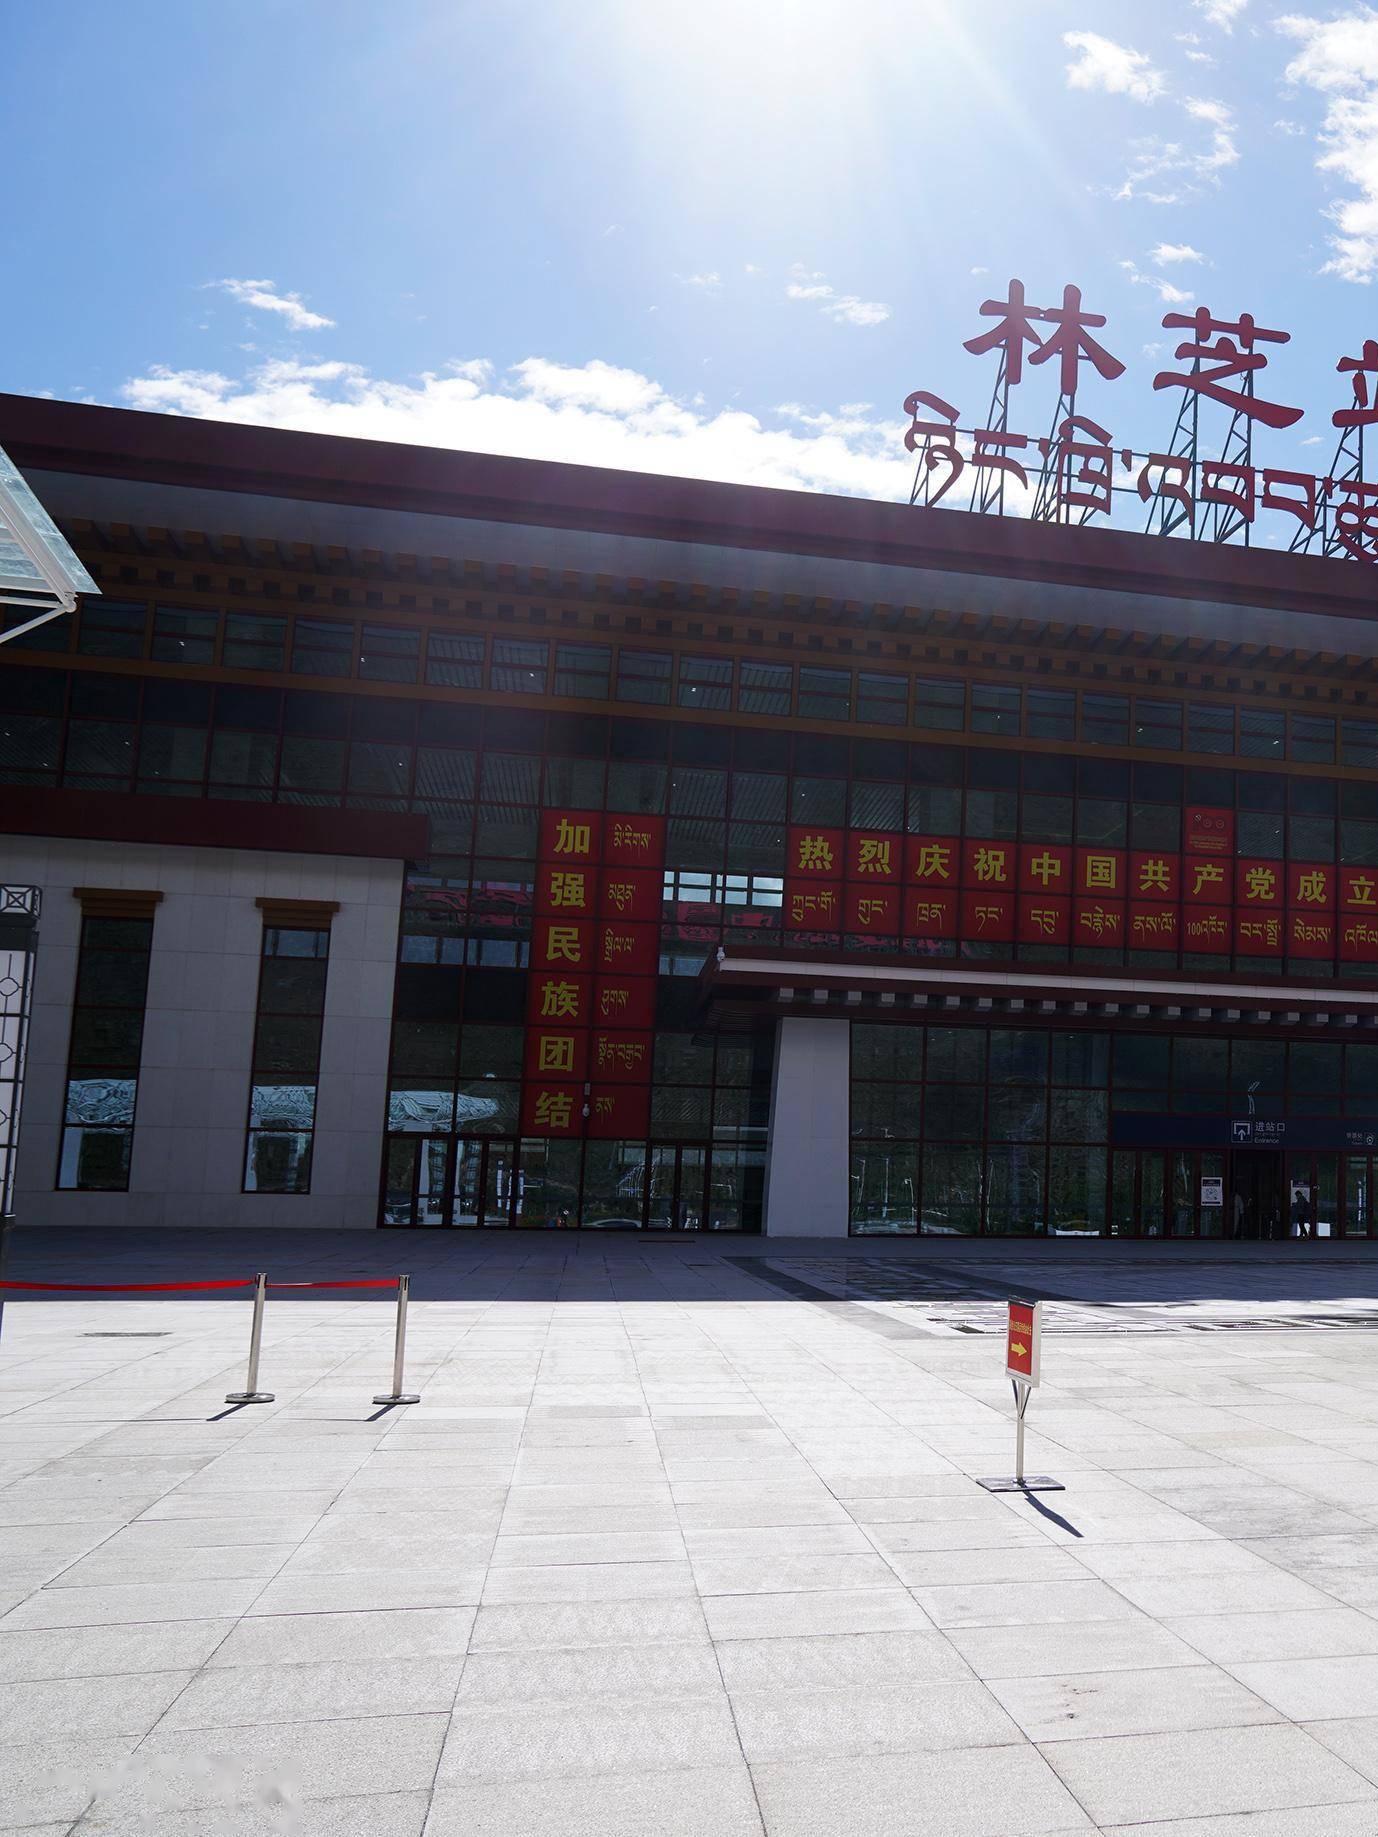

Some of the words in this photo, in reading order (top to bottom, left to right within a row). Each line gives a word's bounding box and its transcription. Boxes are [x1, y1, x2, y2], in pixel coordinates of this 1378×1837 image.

[533, 817, 591, 1129] 加强民族团结
[1254, 1121, 1286, 1132] 进站口
